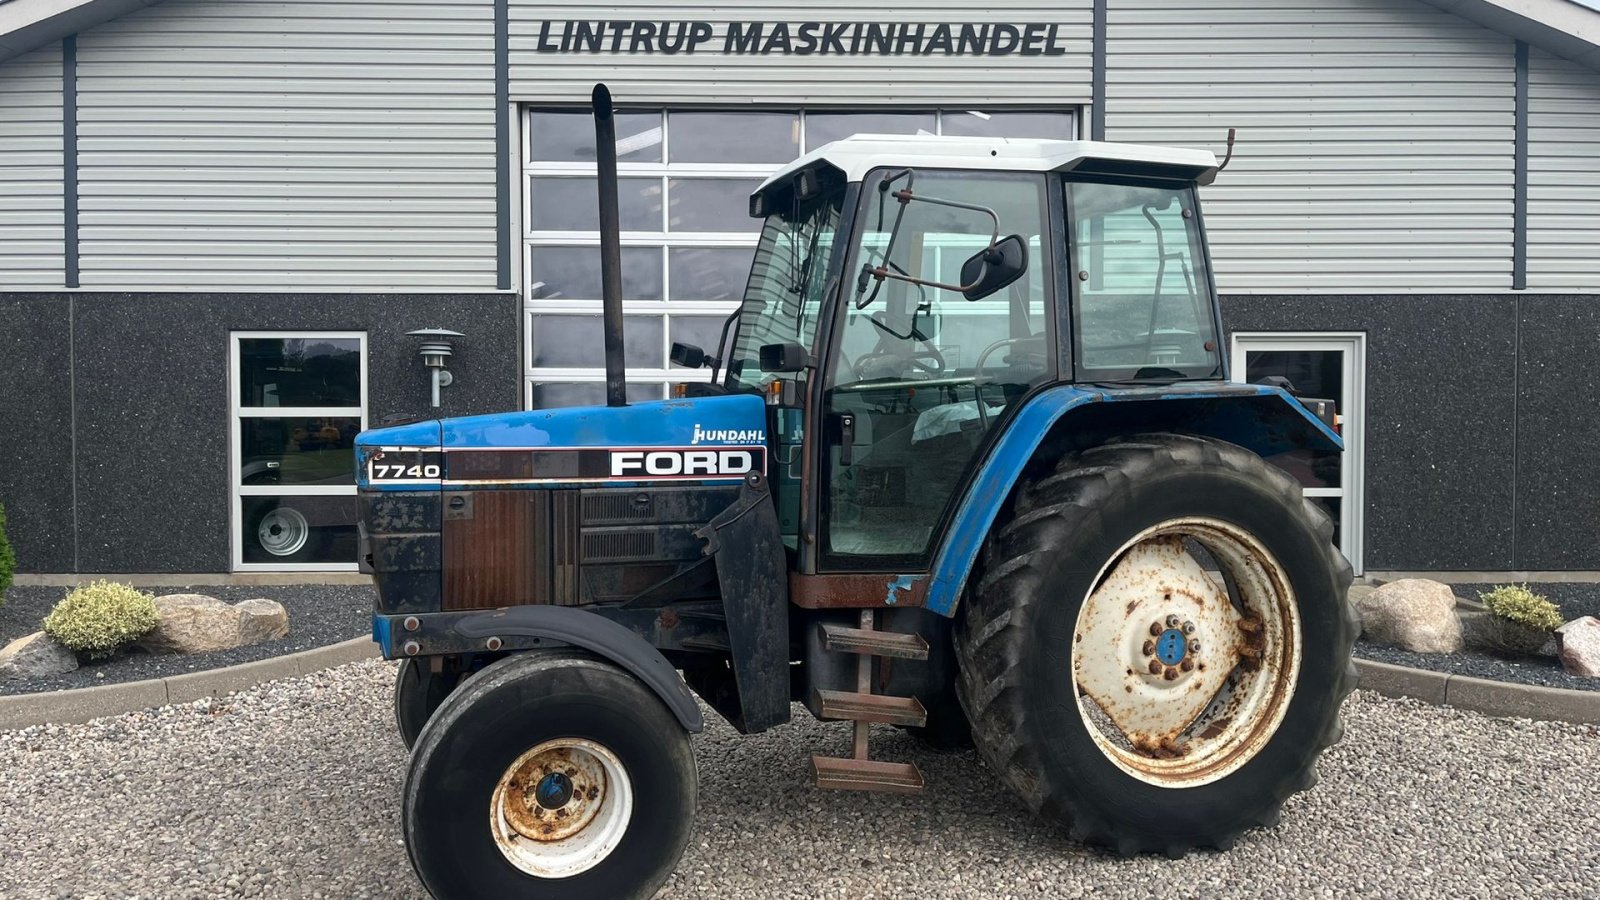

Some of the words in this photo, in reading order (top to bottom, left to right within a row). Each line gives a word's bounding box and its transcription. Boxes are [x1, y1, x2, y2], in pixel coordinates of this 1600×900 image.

[537, 20, 713, 54] LINTRUP
[725, 22, 1066, 56] MASKINHANDEL
[374, 464, 440, 478] 7740
[610, 450, 753, 476] FORD
